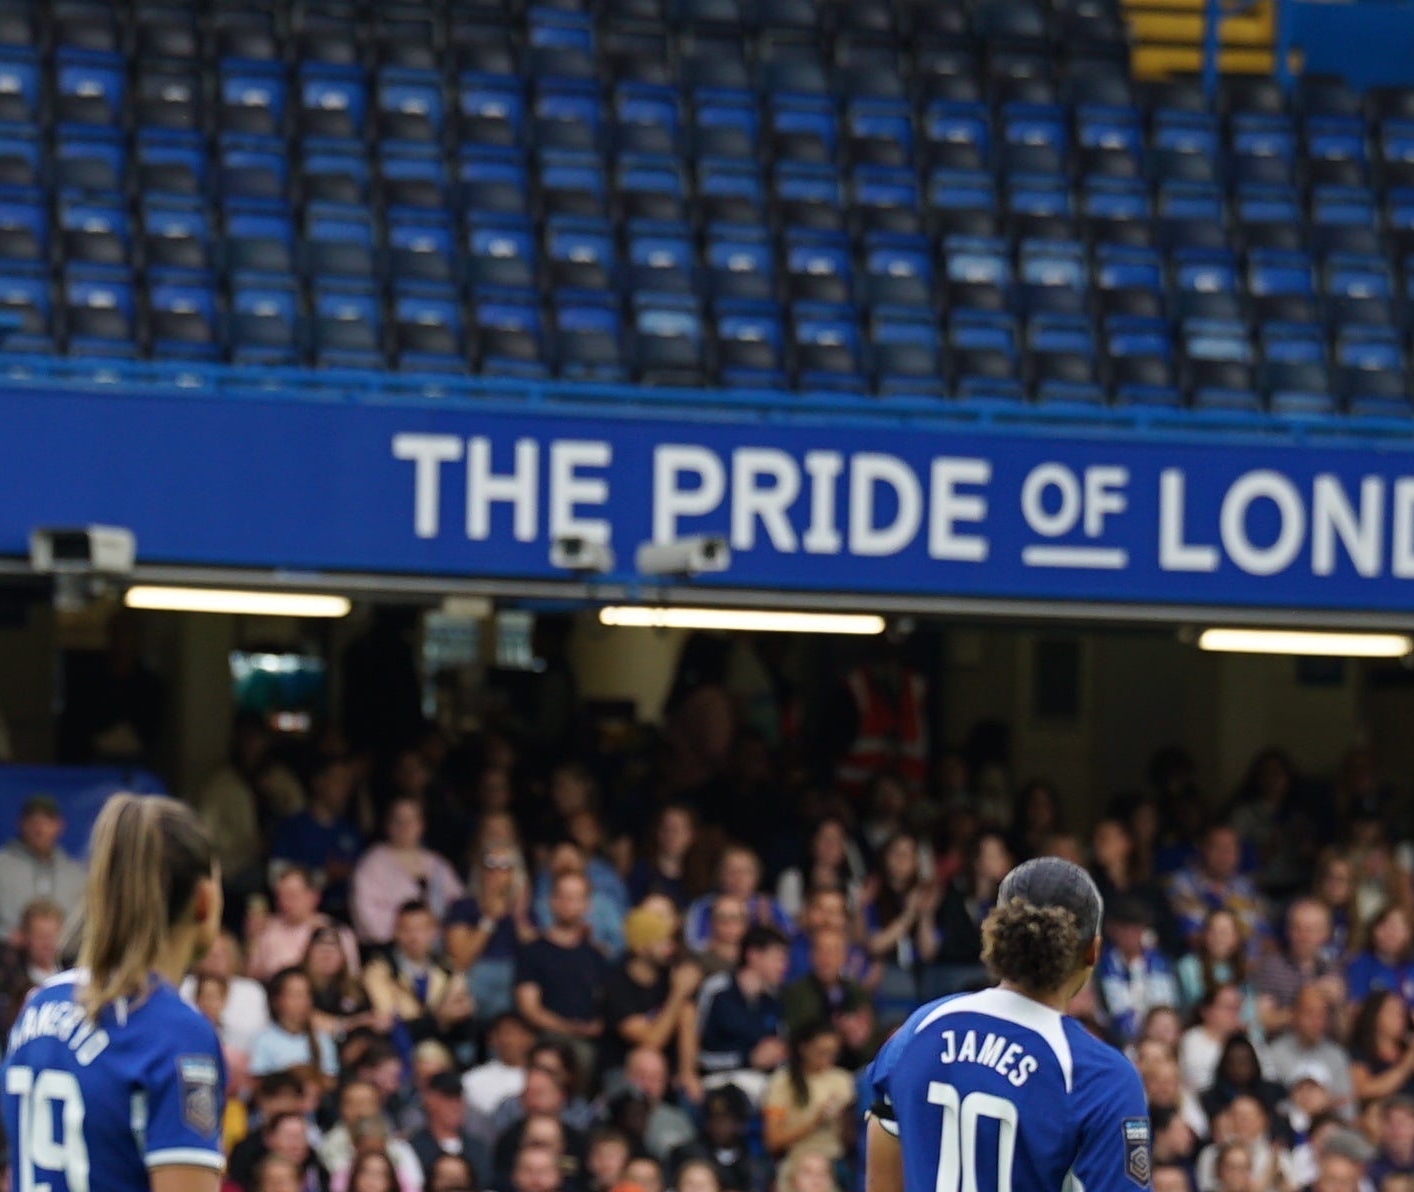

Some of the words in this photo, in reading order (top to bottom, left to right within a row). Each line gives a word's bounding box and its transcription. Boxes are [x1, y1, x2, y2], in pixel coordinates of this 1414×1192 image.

[392, 432, 613, 546] THE
[653, 443, 992, 562] PRIDE
[1020, 461, 1129, 539] OF
[940, 1029, 1038, 1088] JAMES
